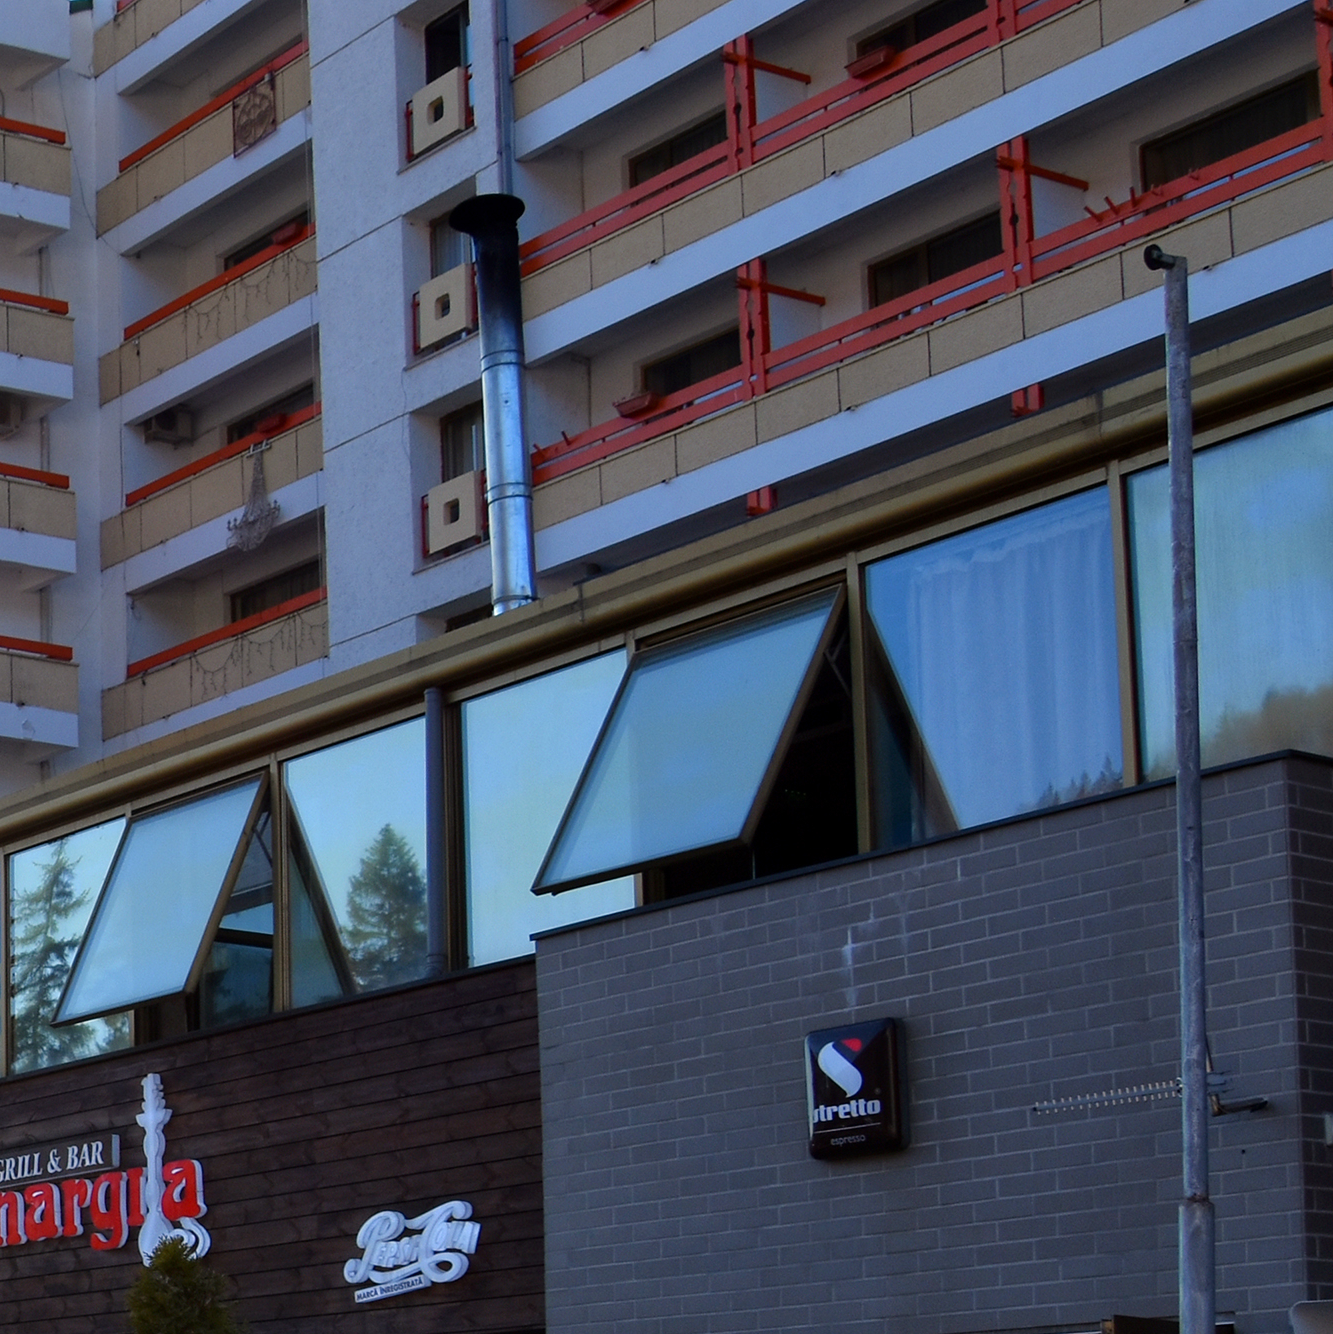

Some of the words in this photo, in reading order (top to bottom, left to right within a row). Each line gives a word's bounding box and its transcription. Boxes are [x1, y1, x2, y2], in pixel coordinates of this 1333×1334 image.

[813, 1098, 882, 1123] stretto
[830, 1134, 866, 1147] espresso
[47, 1149, 62, 1173] &
[67, 1140, 104, 1170] BAR
